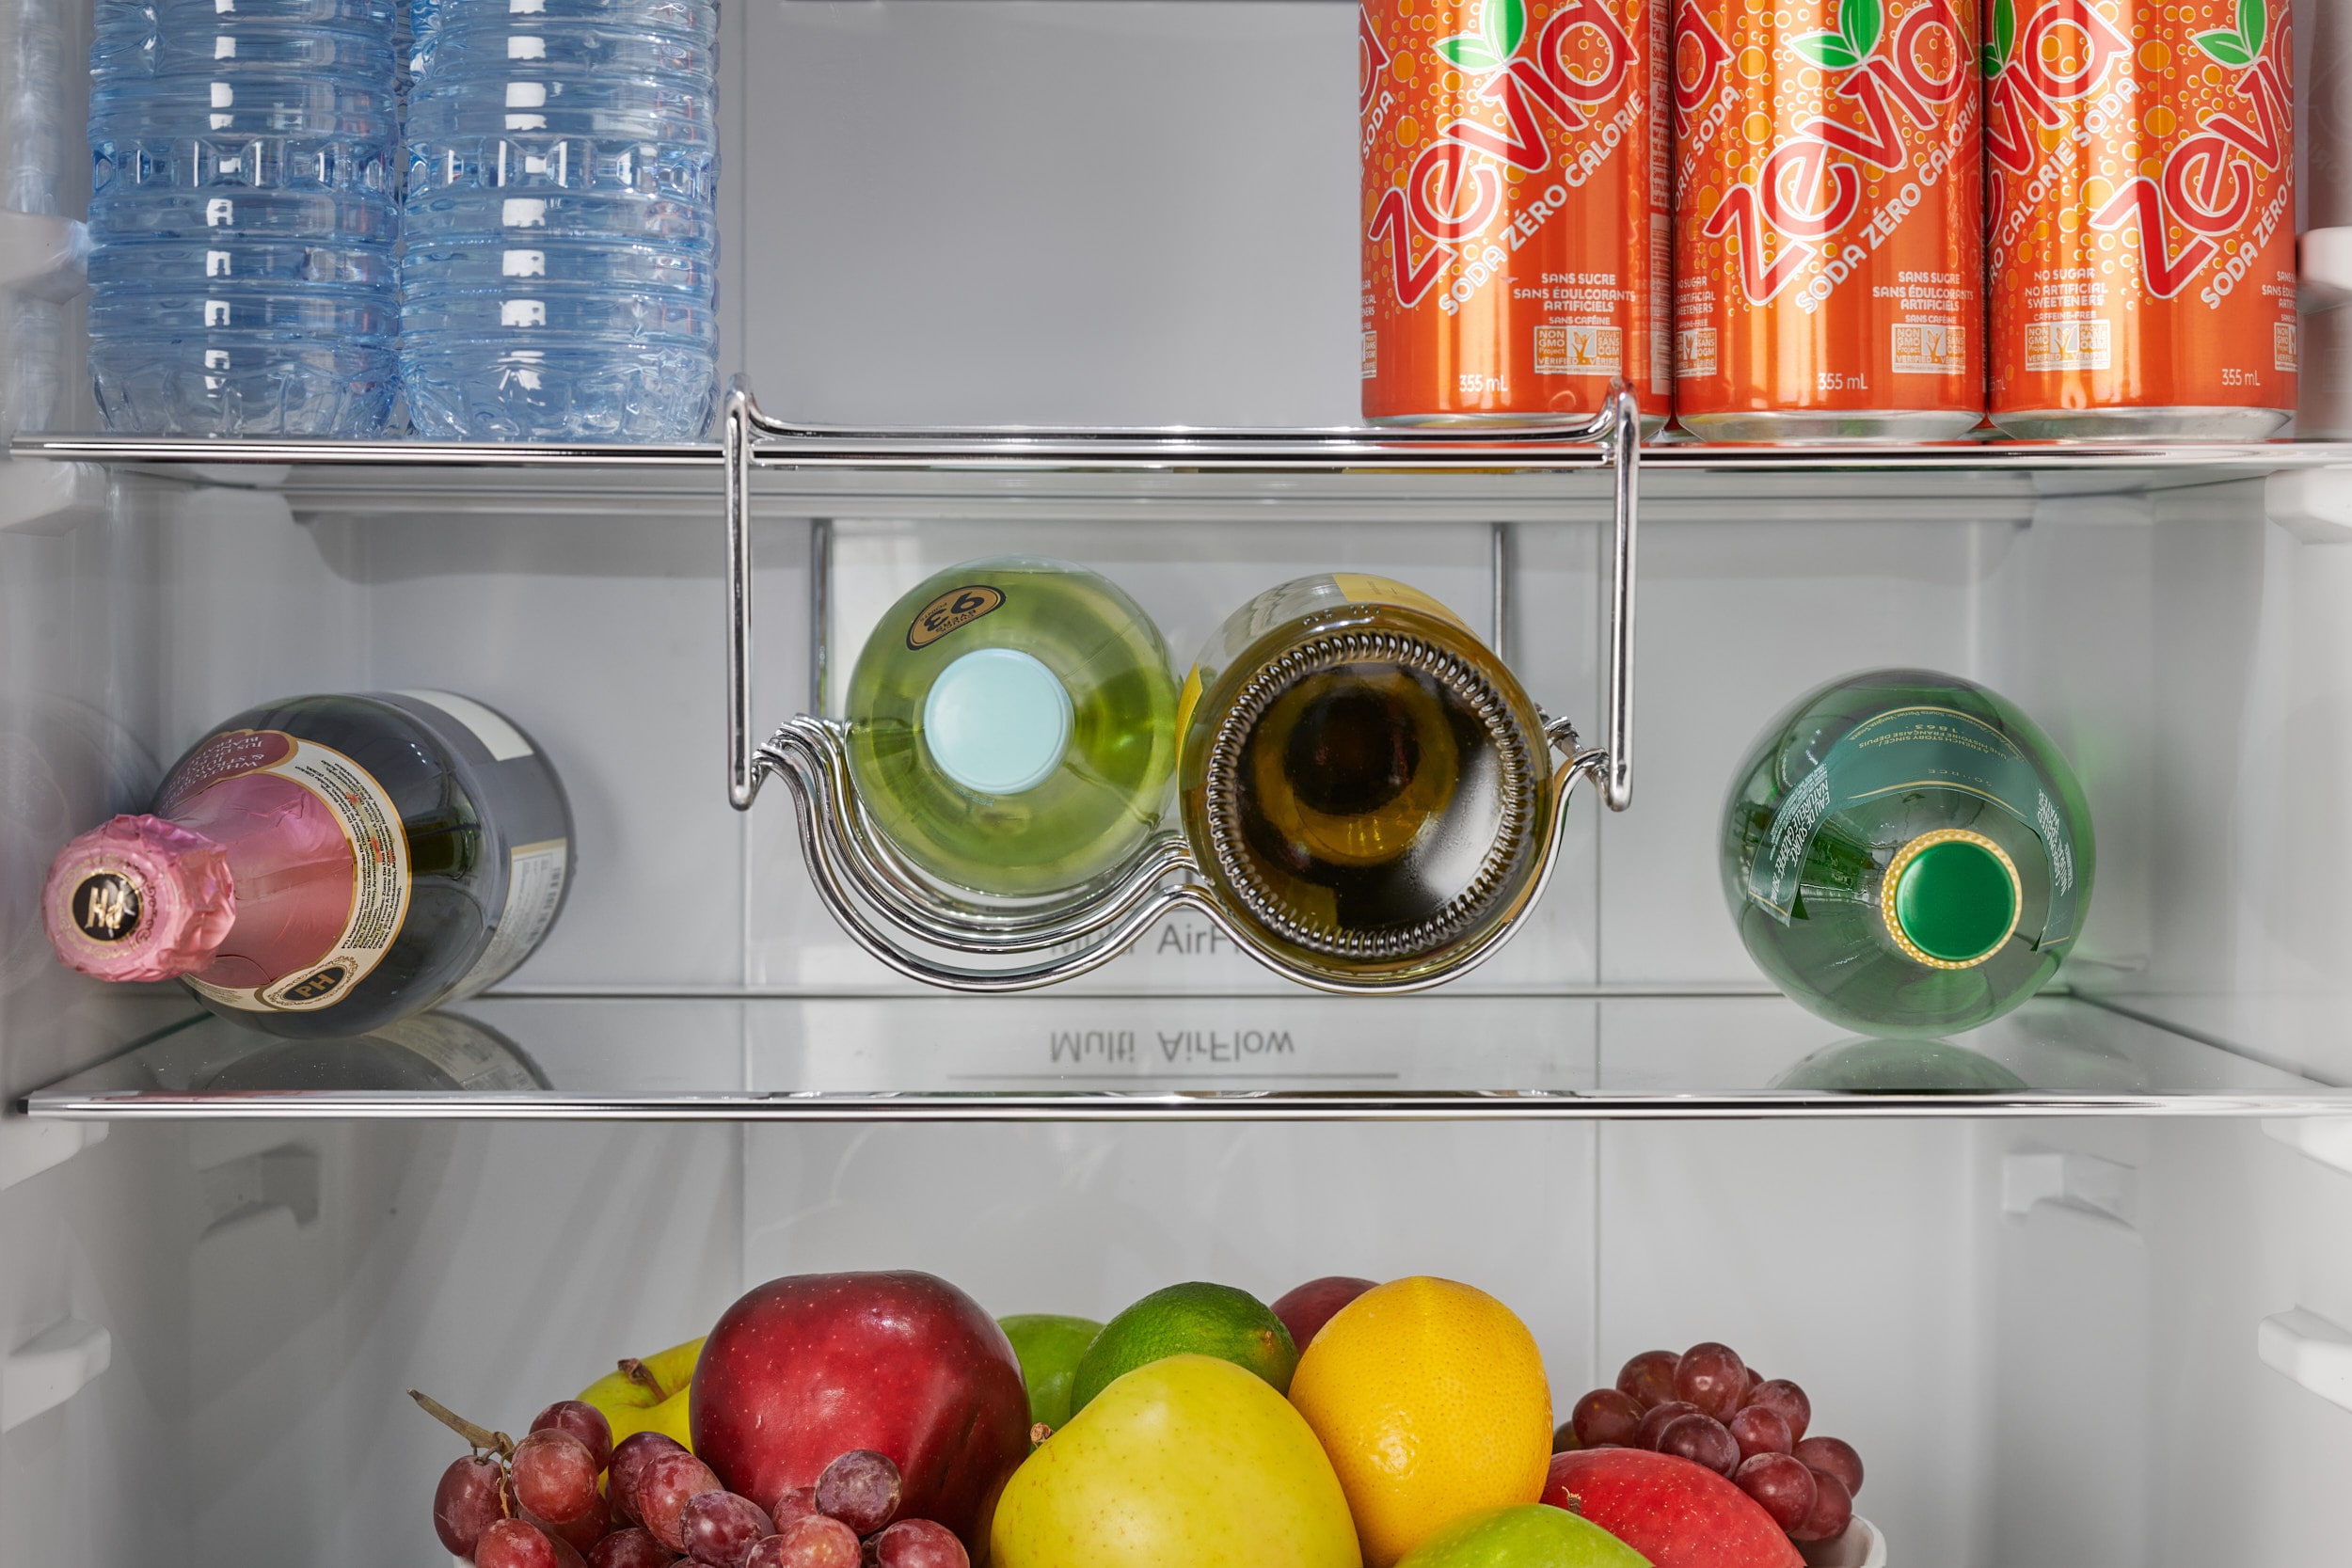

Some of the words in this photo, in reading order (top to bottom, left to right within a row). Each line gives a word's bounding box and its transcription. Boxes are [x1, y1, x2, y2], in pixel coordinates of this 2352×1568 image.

[1363, 89, 1396, 161] SODA
[1692, 85, 1740, 155] SODA
[2002, 140, 2078, 247] CALORIE
[2074, 77, 2141, 148] SODA
[1438, 245, 1509, 317] SODA
[1500, 182, 1568, 253] ZÉRO
[1564, 89, 1647, 187] CALORIE
[1795, 244, 1868, 316] SODA
[1859, 182, 1922, 251] ZÉRO
[1918, 88, 1978, 188] CALORIE
[2200, 243, 2260, 310] SODA
[2252, 182, 2288, 249] ZÉRO
[1541, 273, 1576, 284] SANS
[1578, 273, 1616, 285] SUCRE
[1899, 271, 1929, 283] SANS
[1931, 272, 1960, 284] SUCRE
[2034, 270, 2050, 281] NO
[2053, 267, 2095, 280] SUGAR
[1684, 276, 1708, 288] SUGAR
[1513, 288, 1549, 300] SANS
[1552, 286, 1636, 302] ÉDULCORANTS
[1872, 286, 1906, 297] SANS
[1908, 284, 1974, 300] ÉDULCORANTS
[2025, 286, 2040, 296] NO
[2042, 283, 2109, 296] ARTIFICIAL
[2262, 284, 2281, 295] SANS
[1544, 300, 1614, 312] ARTIFICIELS
[1900, 298, 1960, 311] ARTIFICIELS
[2027, 294, 2105, 309] SWEETENERS
[1549, 316, 1573, 325] SANS
[1574, 315, 1611, 325] CAFÉINE
[1905, 315, 1928, 324] SANS
[2034, 310, 2097, 321] CAFFEINE-FREE
[1539, 330, 1565, 339] NON
[1897, 328, 1920, 338] NON
[2028, 327, 2049, 336] NON
[1538, 339, 1565, 347] GMO
[1597, 338, 1620, 346] SANS
[1897, 338, 1920, 346] GMO
[2028, 336, 2049, 344] GMO
[1597, 346, 1620, 356] OGM
[1538, 356, 1579, 365] VERIFIED
[1459, 374, 1483, 392] 355
[1486, 374, 1509, 392] mL
[1818, 372, 1843, 390] 355
[1847, 372, 1868, 389] mL
[2222, 368, 2242, 386] 355
[2244, 368, 2261, 386] mL
[924, 592, 984, 631] 93
[1893, 729, 1945, 737] FRANÇAISE
[1858, 734, 1891, 749] DEPUIS
[1945, 737, 1981, 752] FRENCH
[1947, 733, 1988, 750] HISTOIRE
[1791, 779, 1828, 833] NATURELLE
[1816, 791, 1831, 816] EAU
[1804, 808, 1817, 831] DE
[1788, 824, 1808, 867] SOURCE
[294, 973, 336, 999] PH
